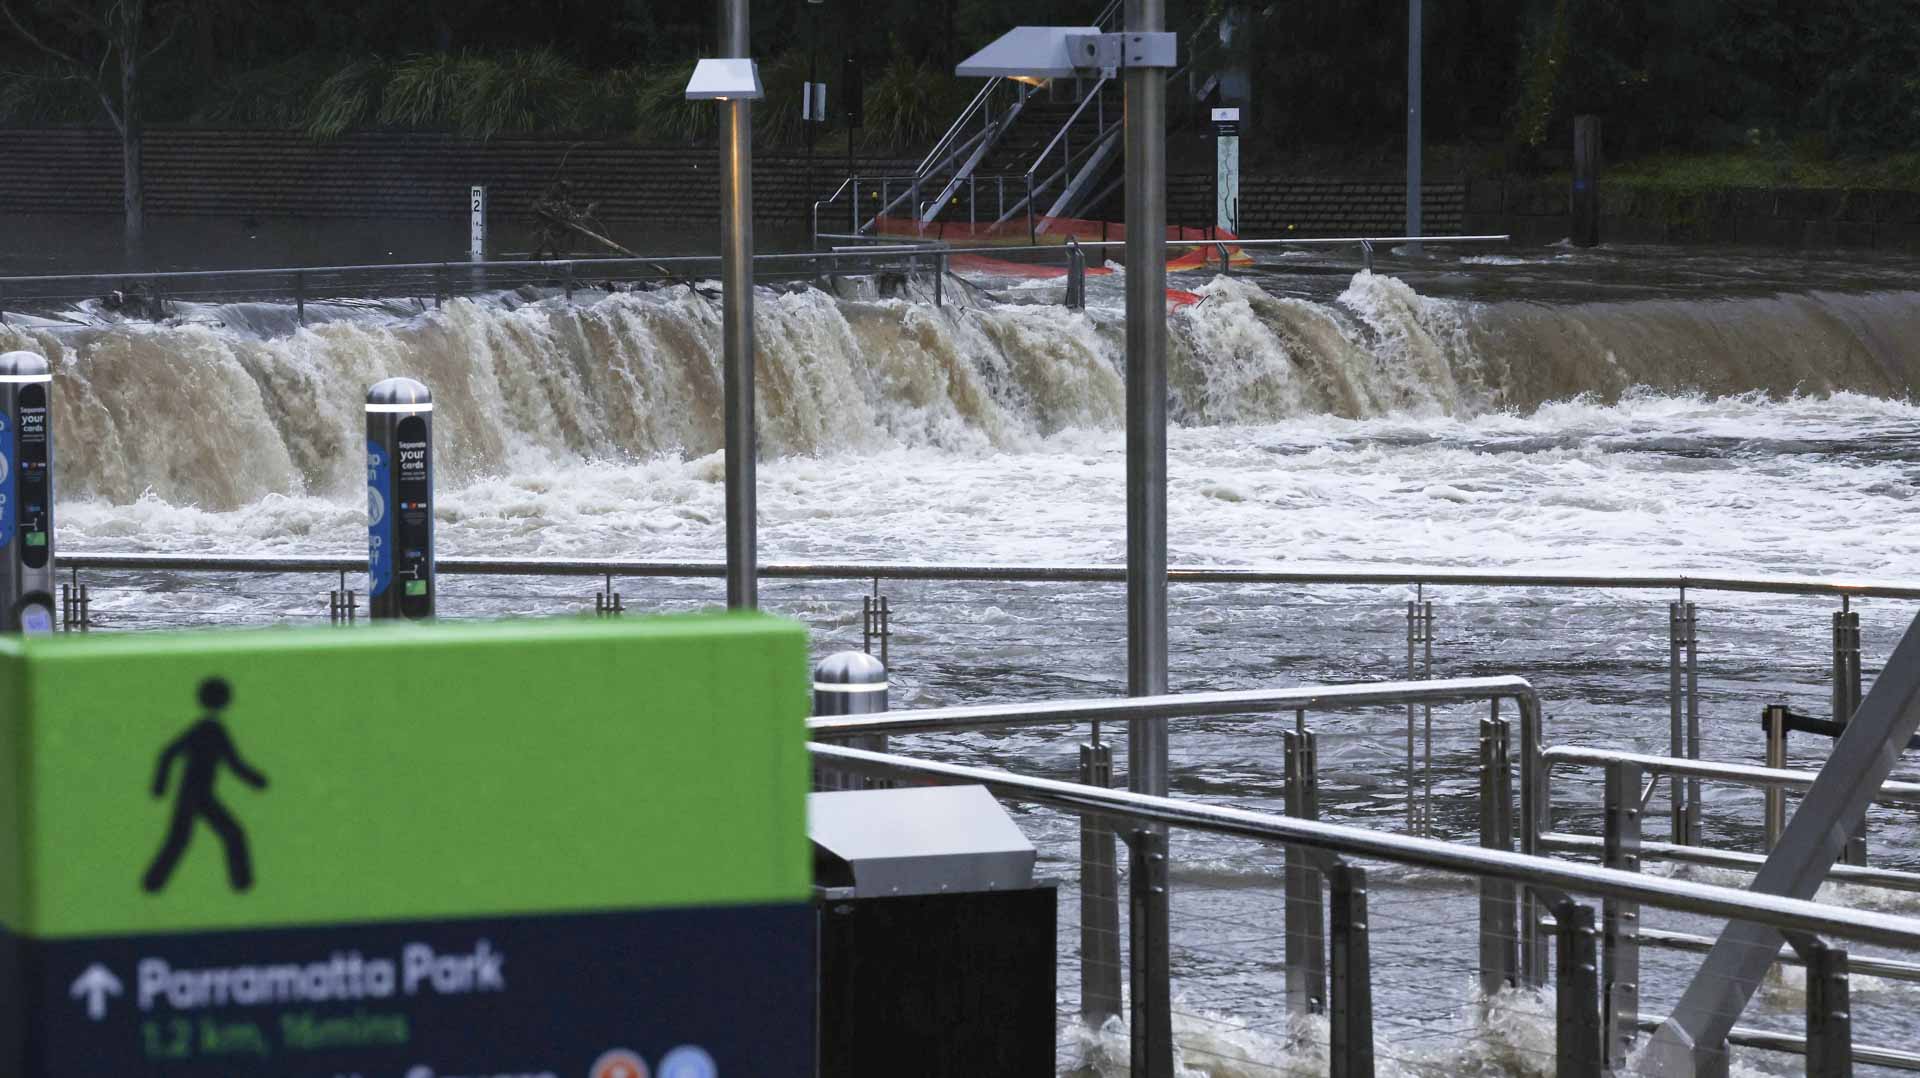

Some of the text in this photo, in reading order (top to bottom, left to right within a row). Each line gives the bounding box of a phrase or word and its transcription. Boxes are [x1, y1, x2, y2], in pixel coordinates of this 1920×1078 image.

[472, 189, 481, 197] m
[473, 199, 481, 212] 2
[21, 415, 44, 426] your
[399, 441, 426, 450] Separate
[400, 450, 424, 462] your
[401, 460, 424, 469] cards
[138, 940, 505, 1010] Parramatta Park
